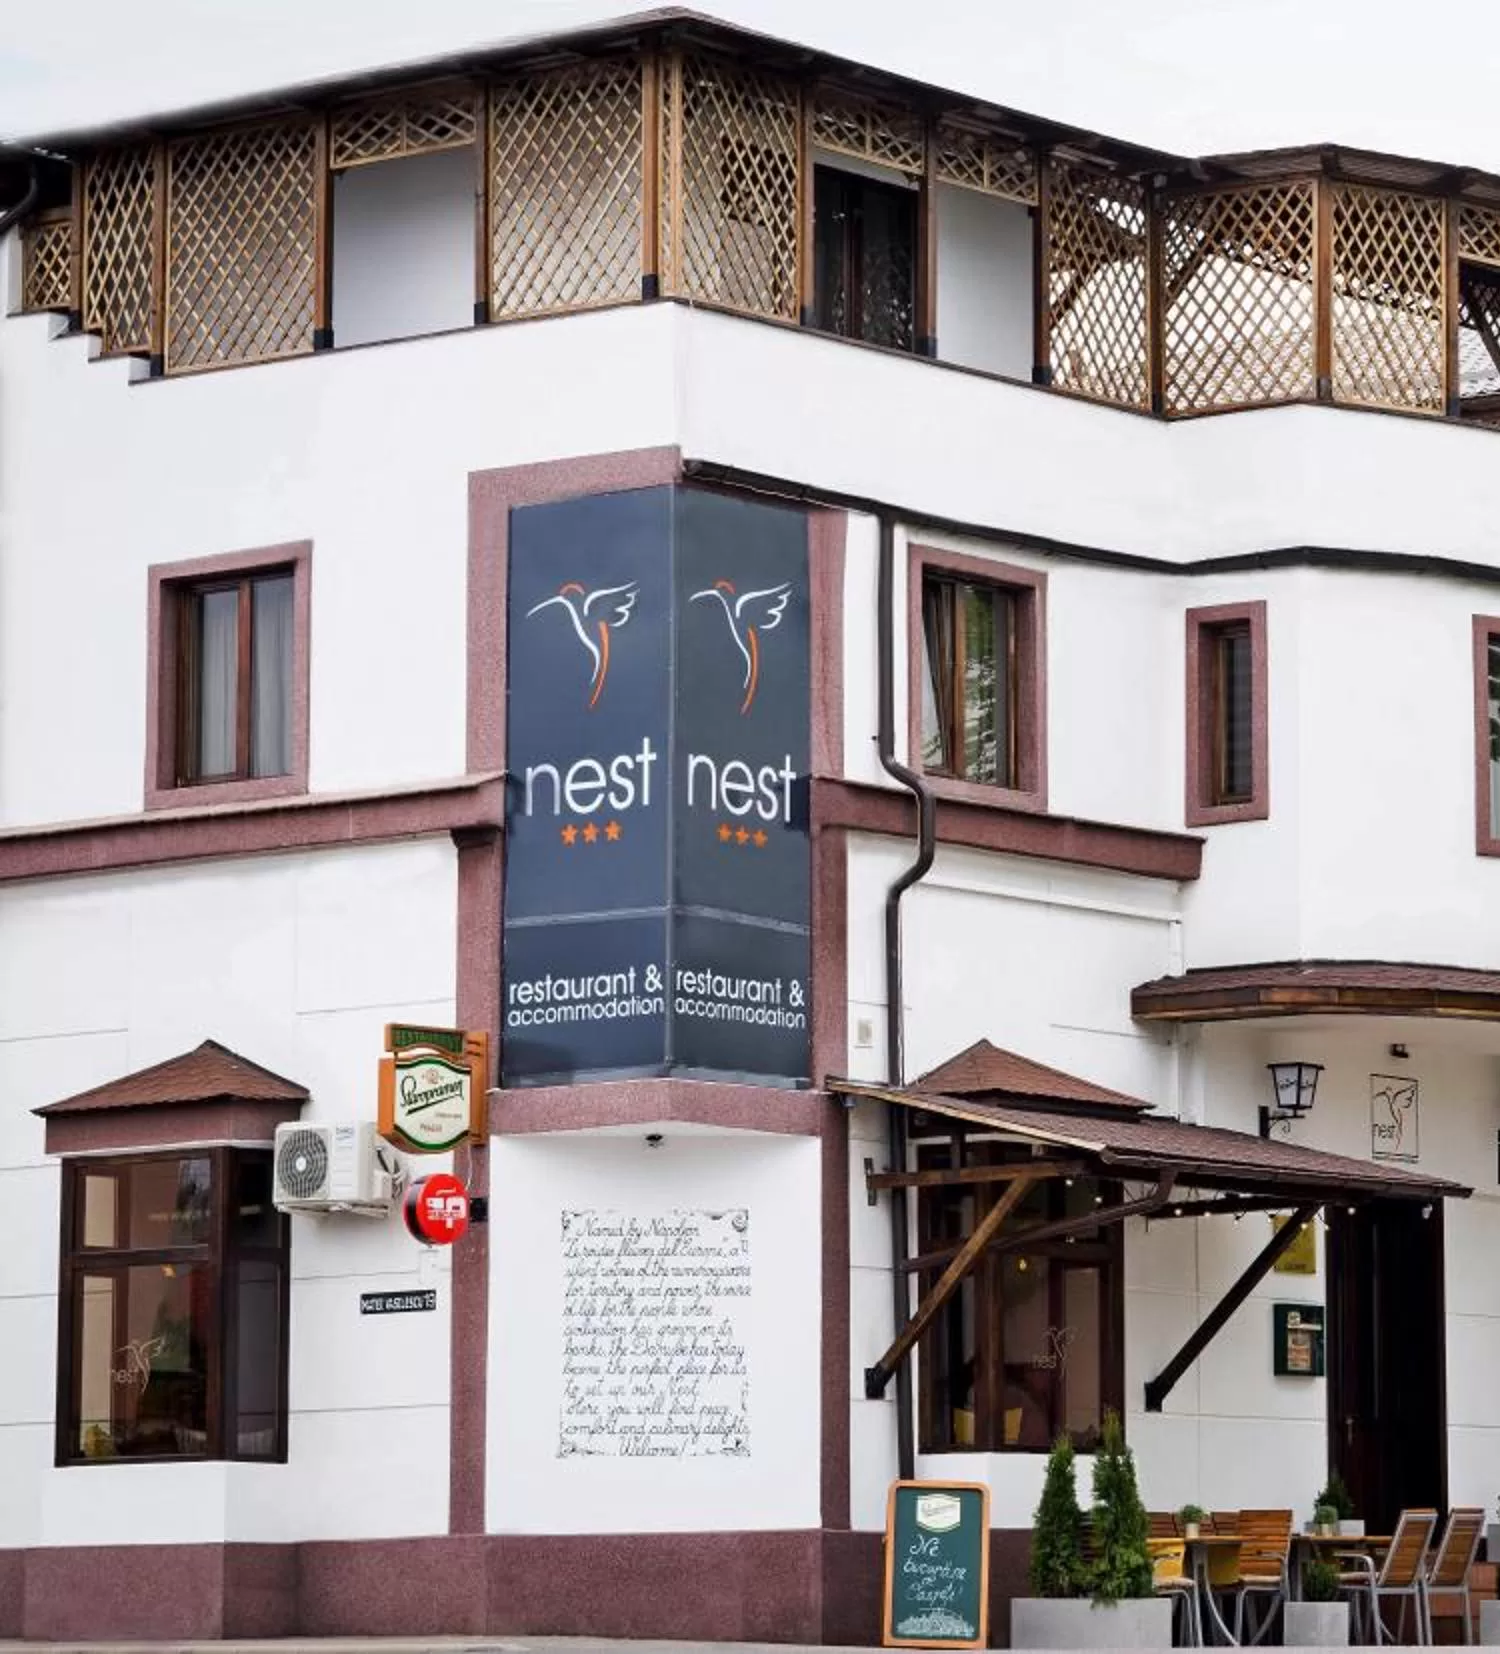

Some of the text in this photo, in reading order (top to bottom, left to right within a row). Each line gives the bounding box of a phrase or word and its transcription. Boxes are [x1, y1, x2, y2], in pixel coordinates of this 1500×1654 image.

[525, 737, 657, 816] nest
[687, 753, 797, 823] nest
[509, 963, 664, 1005] restaurant &
[675, 967, 805, 1007] restaurant &
[507, 996, 665, 1028] accommodation
[674, 997, 806, 1029] accommodation
[400, 1075, 465, 1108] Staropramen
